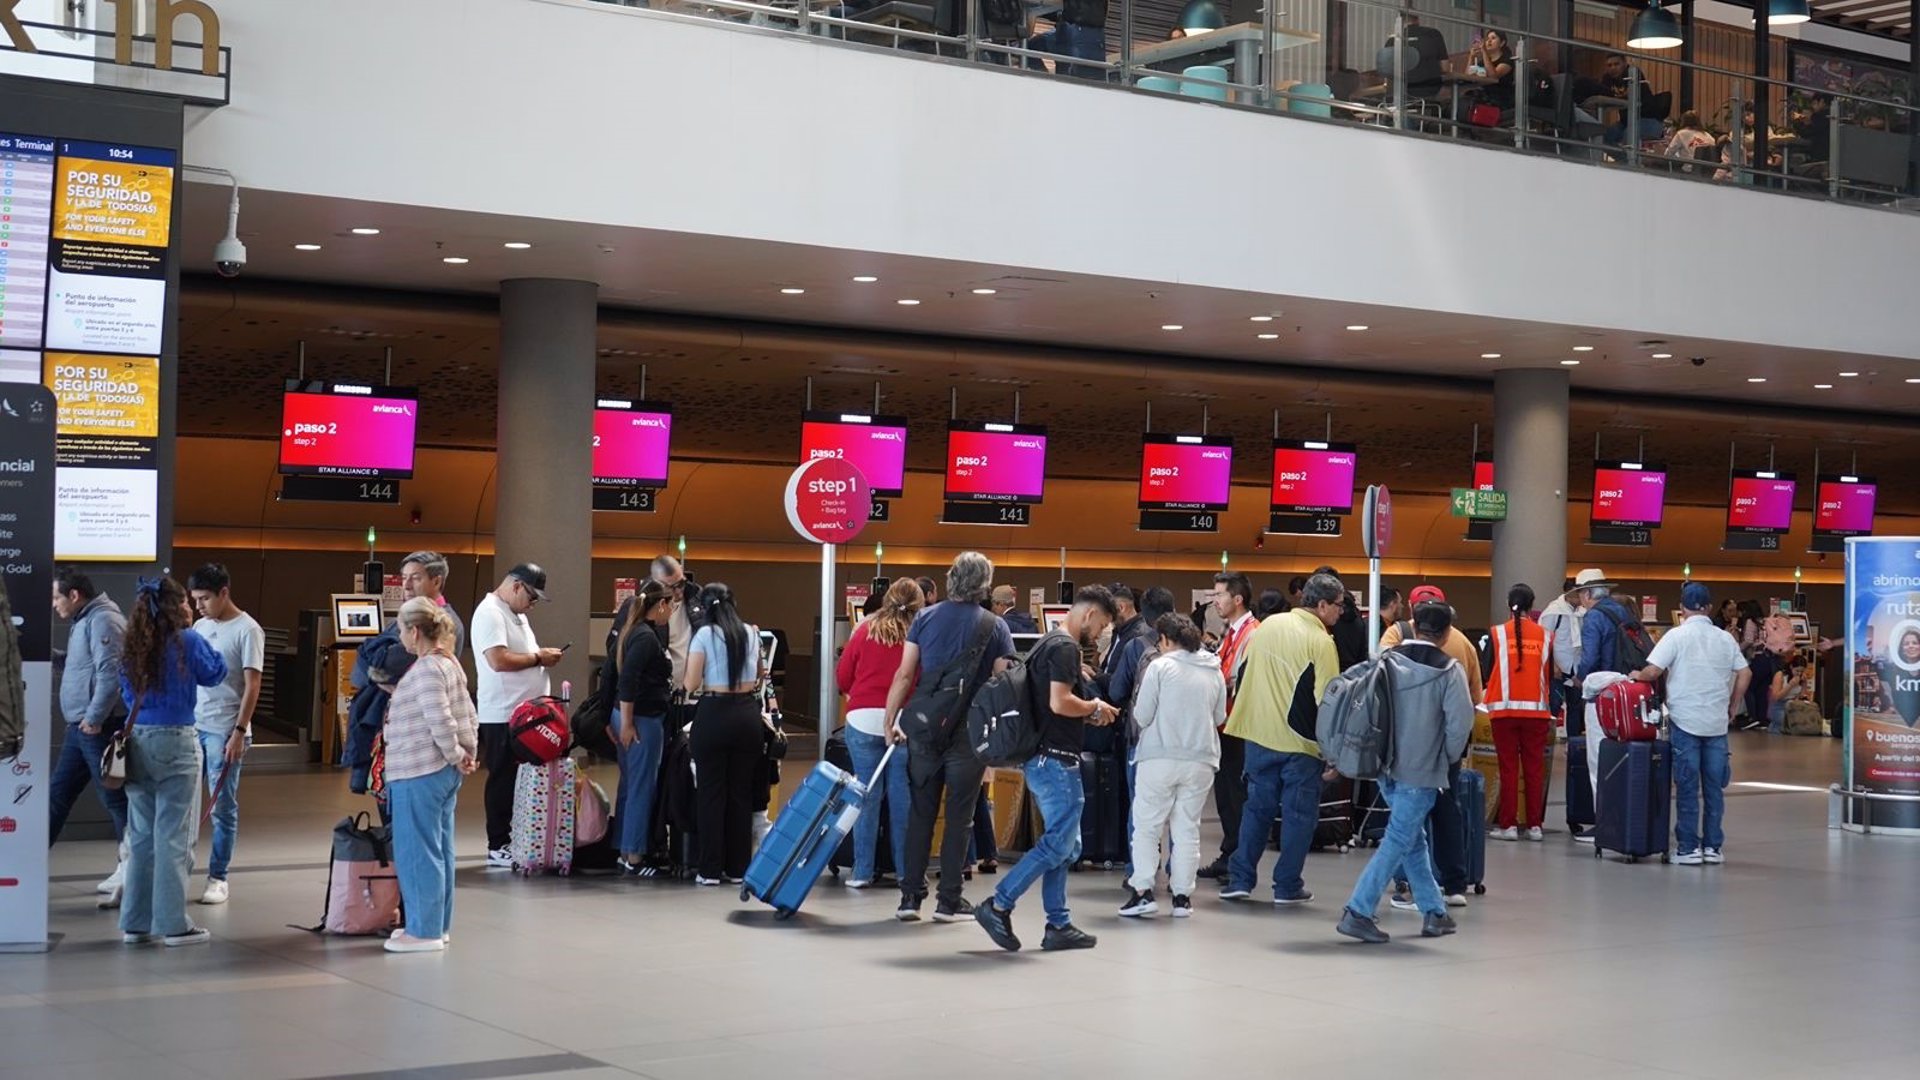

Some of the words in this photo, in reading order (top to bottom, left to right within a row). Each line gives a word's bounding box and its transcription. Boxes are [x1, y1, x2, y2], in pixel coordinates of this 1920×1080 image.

[15, 139, 54, 151] Terminal
[65, 143, 69, 152] 1
[109, 148, 133, 159] 10:54
[67, 171, 98, 185] POR
[102, 174, 122, 187] SU
[67, 185, 152, 203] SEGURIDAD
[66, 198, 72, 206] Y
[88, 200, 102, 209] DE
[107, 202, 157, 214] TODOS(AS)
[65, 213, 82, 222] FOR
[84, 214, 106, 224] YOUR
[108, 216, 136, 226] SAFETY
[84, 225, 127, 235] EVERYONE
[128, 228, 147, 237] ELSE
[55, 366, 85, 378] POR
[89, 367, 108, 379] SU
[54, 380, 139, 394] SEGURIDAD
[77, 394, 90, 402] DE
[95, 394, 145, 406] TODOS(AS)
[57, 407, 72, 415] OR
[72, 408, 94, 417] YOUR
[96, 409, 125, 417] SAFETY
[373, 405, 402, 414] avianca
[74, 419, 116, 427] EVERYONE
[117, 420, 136, 428] ELSE
[632, 418, 658, 426] avianca
[294, 423, 326, 435] paso
[328, 422, 337, 434] 2
[593, 435, 601, 446] 2
[871, 432, 896, 440] avianca
[294, 438, 310, 446] step
[311, 438, 317, 446] 2
[1014, 440, 1036, 448] avianca
[810, 449, 835, 460] paso
[837, 448, 844, 459] 2
[0, 459, 35, 472] ncial
[956, 457, 980, 467] paso
[981, 456, 988, 466] 2
[338, 467, 371, 475] ALLIANCE
[1150, 468, 1171, 477] paso
[1173, 467, 1179, 476] 2
[1281, 472, 1300, 482] paso
[1301, 472, 1307, 480] 2
[360, 483, 392, 499] 144
[808, 478, 846, 496] step
[849, 477, 856, 492] 1
[620, 492, 648, 507] 143
[1478, 492, 1506, 503] SALIDA
[1600, 490, 1617, 499] paso
[1618, 490, 1623, 498] 2
[1736, 498, 1751, 506] paso
[1823, 501, 1836, 510] paso
[1837, 501, 1842, 509] 2
[825, 507, 837, 515] Bag
[1000, 508, 1024, 521] 141
[1191, 516, 1213, 528] 140
[1316, 520, 1336, 531] 139
[1630, 532, 1648, 542] 137
[1761, 537, 1776, 548] 136
[6, 564, 32, 574] Gold
